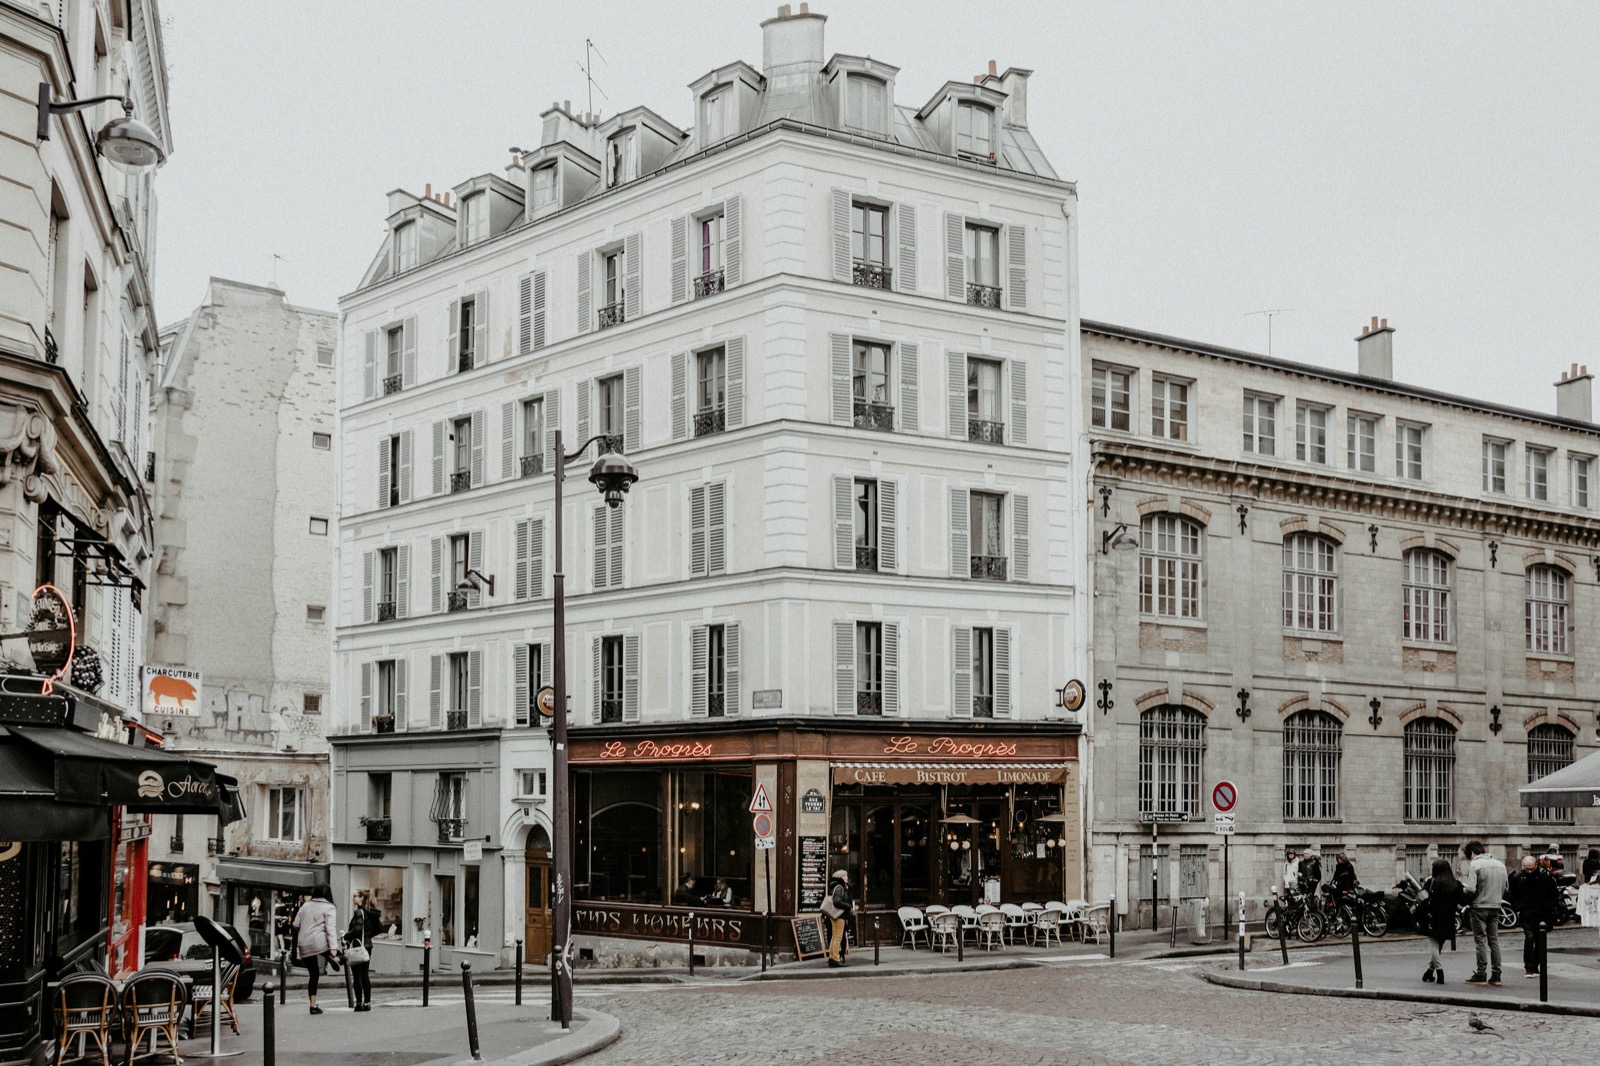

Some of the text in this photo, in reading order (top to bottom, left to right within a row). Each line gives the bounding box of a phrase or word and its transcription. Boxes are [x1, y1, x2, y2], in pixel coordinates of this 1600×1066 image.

[146, 667, 200, 679] CHARCUTERIE
[154, 705, 189, 715] CUISINE
[600, 740, 713, 758] Le Progrès
[883, 736, 1017, 757] Le Progrès
[916, 770, 967, 782] BISTROT
[997, 770, 1051, 782] LIMONADE
